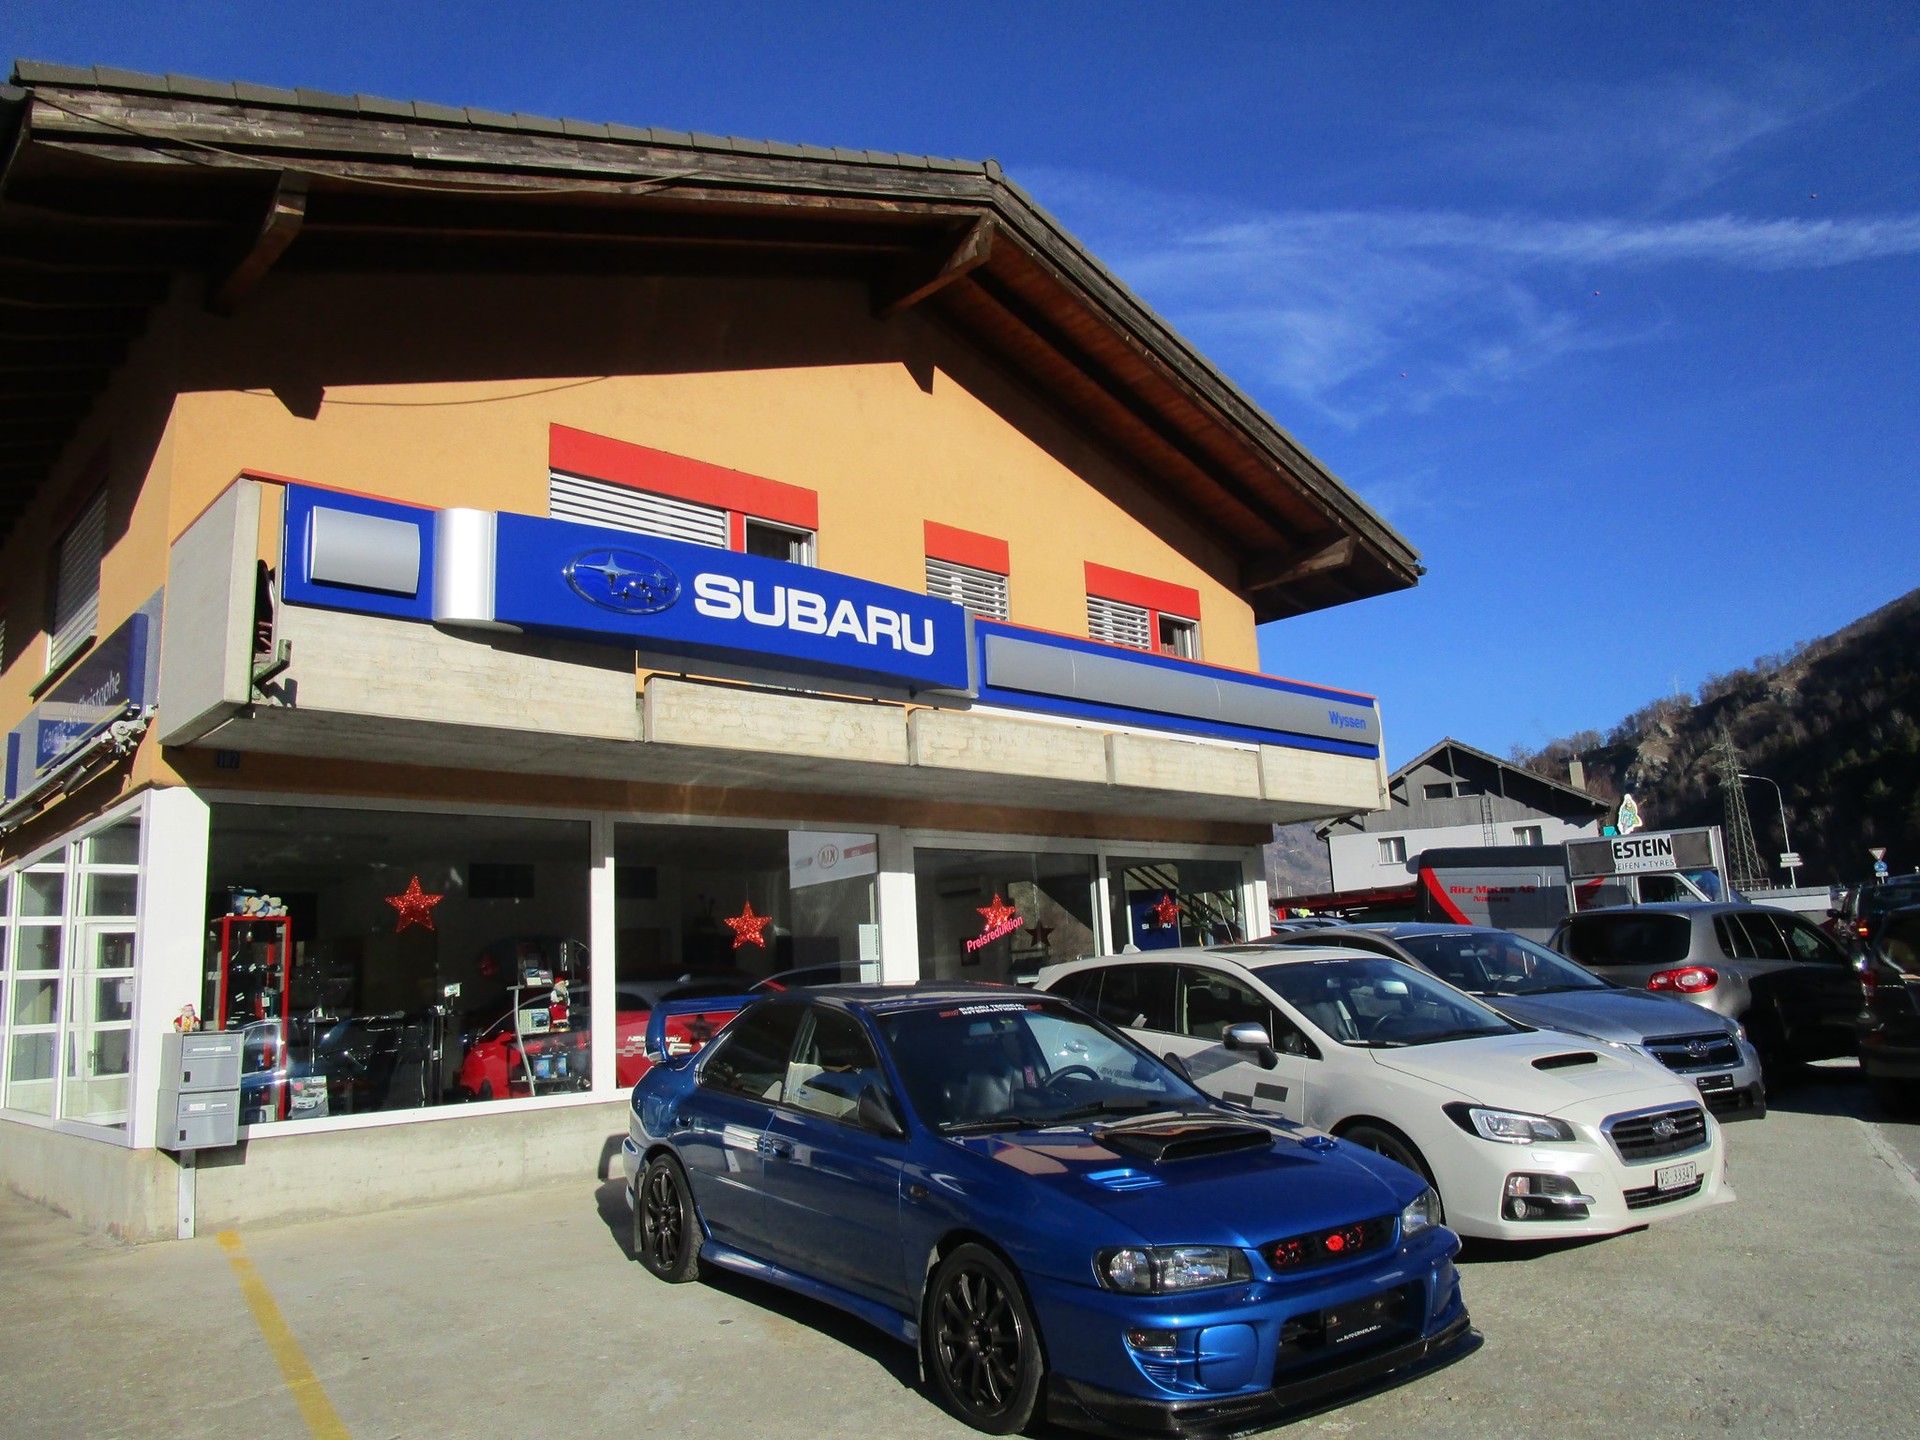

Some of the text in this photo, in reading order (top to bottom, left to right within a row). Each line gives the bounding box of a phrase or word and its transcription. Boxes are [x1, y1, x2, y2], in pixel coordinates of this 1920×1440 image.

[694, 573, 934, 657] SUBARU
[1328, 710, 1367, 730] Wyssen
[1613, 838, 1672, 860] ESTEIN
[1616, 859, 1675, 872] EIFEN TYRES
[1450, 885, 1473, 894] Ritz
[966, 915, 1024, 953] Preisreduktion
